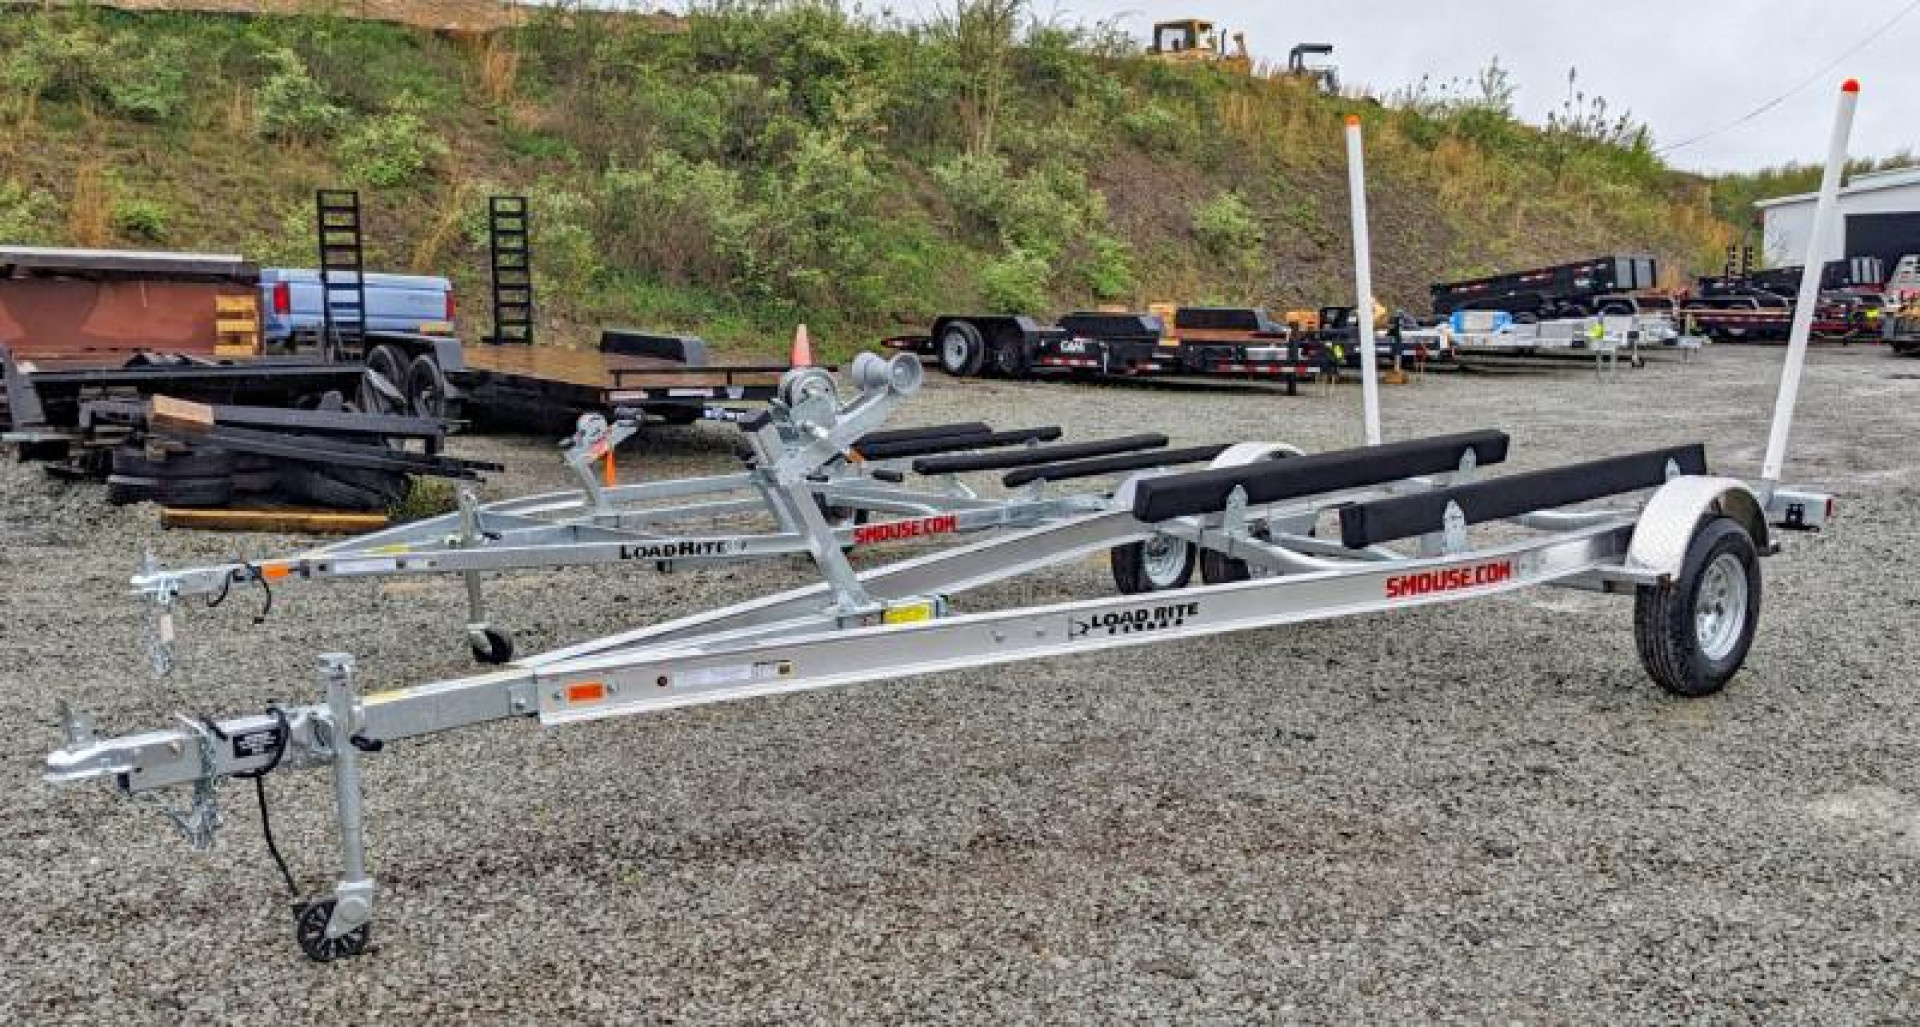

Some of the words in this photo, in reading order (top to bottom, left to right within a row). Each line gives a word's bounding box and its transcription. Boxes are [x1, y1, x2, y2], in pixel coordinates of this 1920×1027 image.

[853, 515, 957, 543] SMOUSE.COM
[1386, 560, 1511, 598] SMOUSE.COM
[1091, 610, 1149, 629] LOAD
[1153, 602, 1200, 621] RITE
